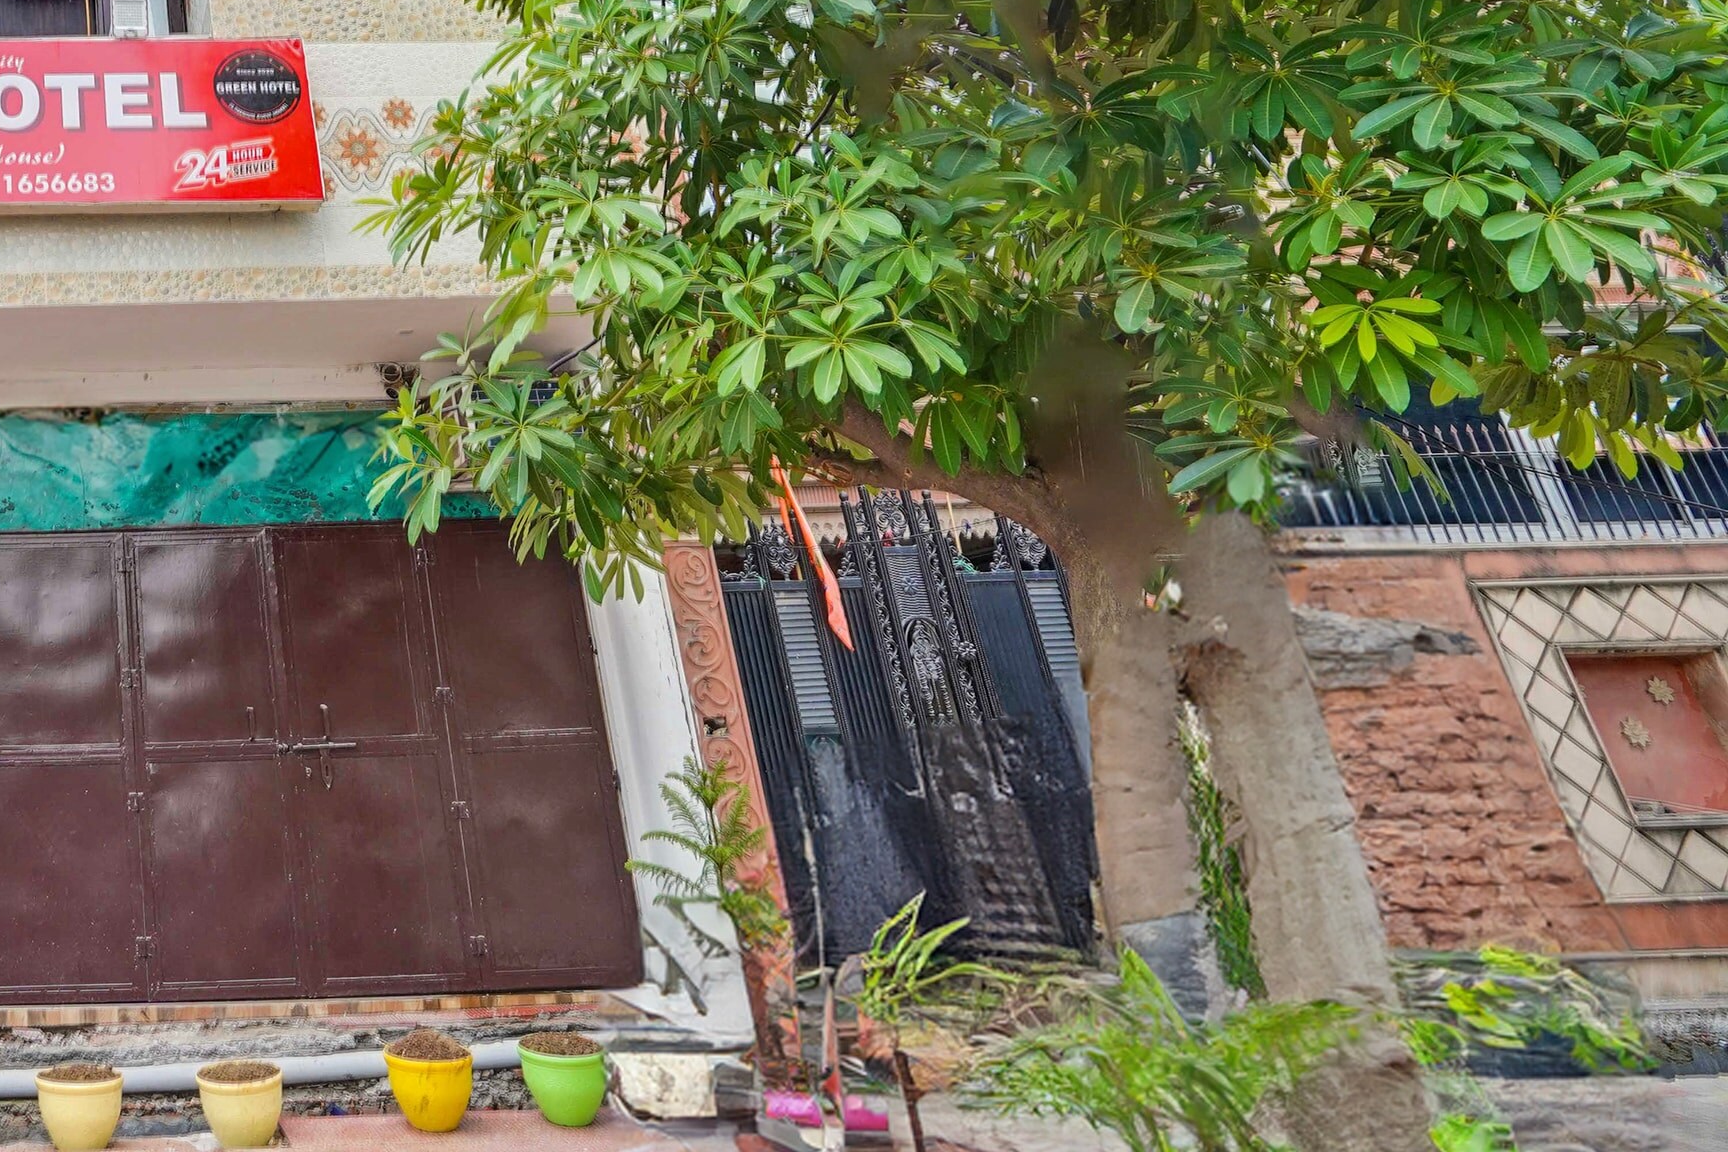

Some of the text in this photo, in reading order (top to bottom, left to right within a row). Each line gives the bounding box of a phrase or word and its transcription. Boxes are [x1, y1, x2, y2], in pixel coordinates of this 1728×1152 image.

[216, 80, 300, 95] GREEN HOTEL
[232, 147, 264, 162] HOUR
[175, 146, 230, 190] 24
[232, 159, 276, 176] SERVICE
